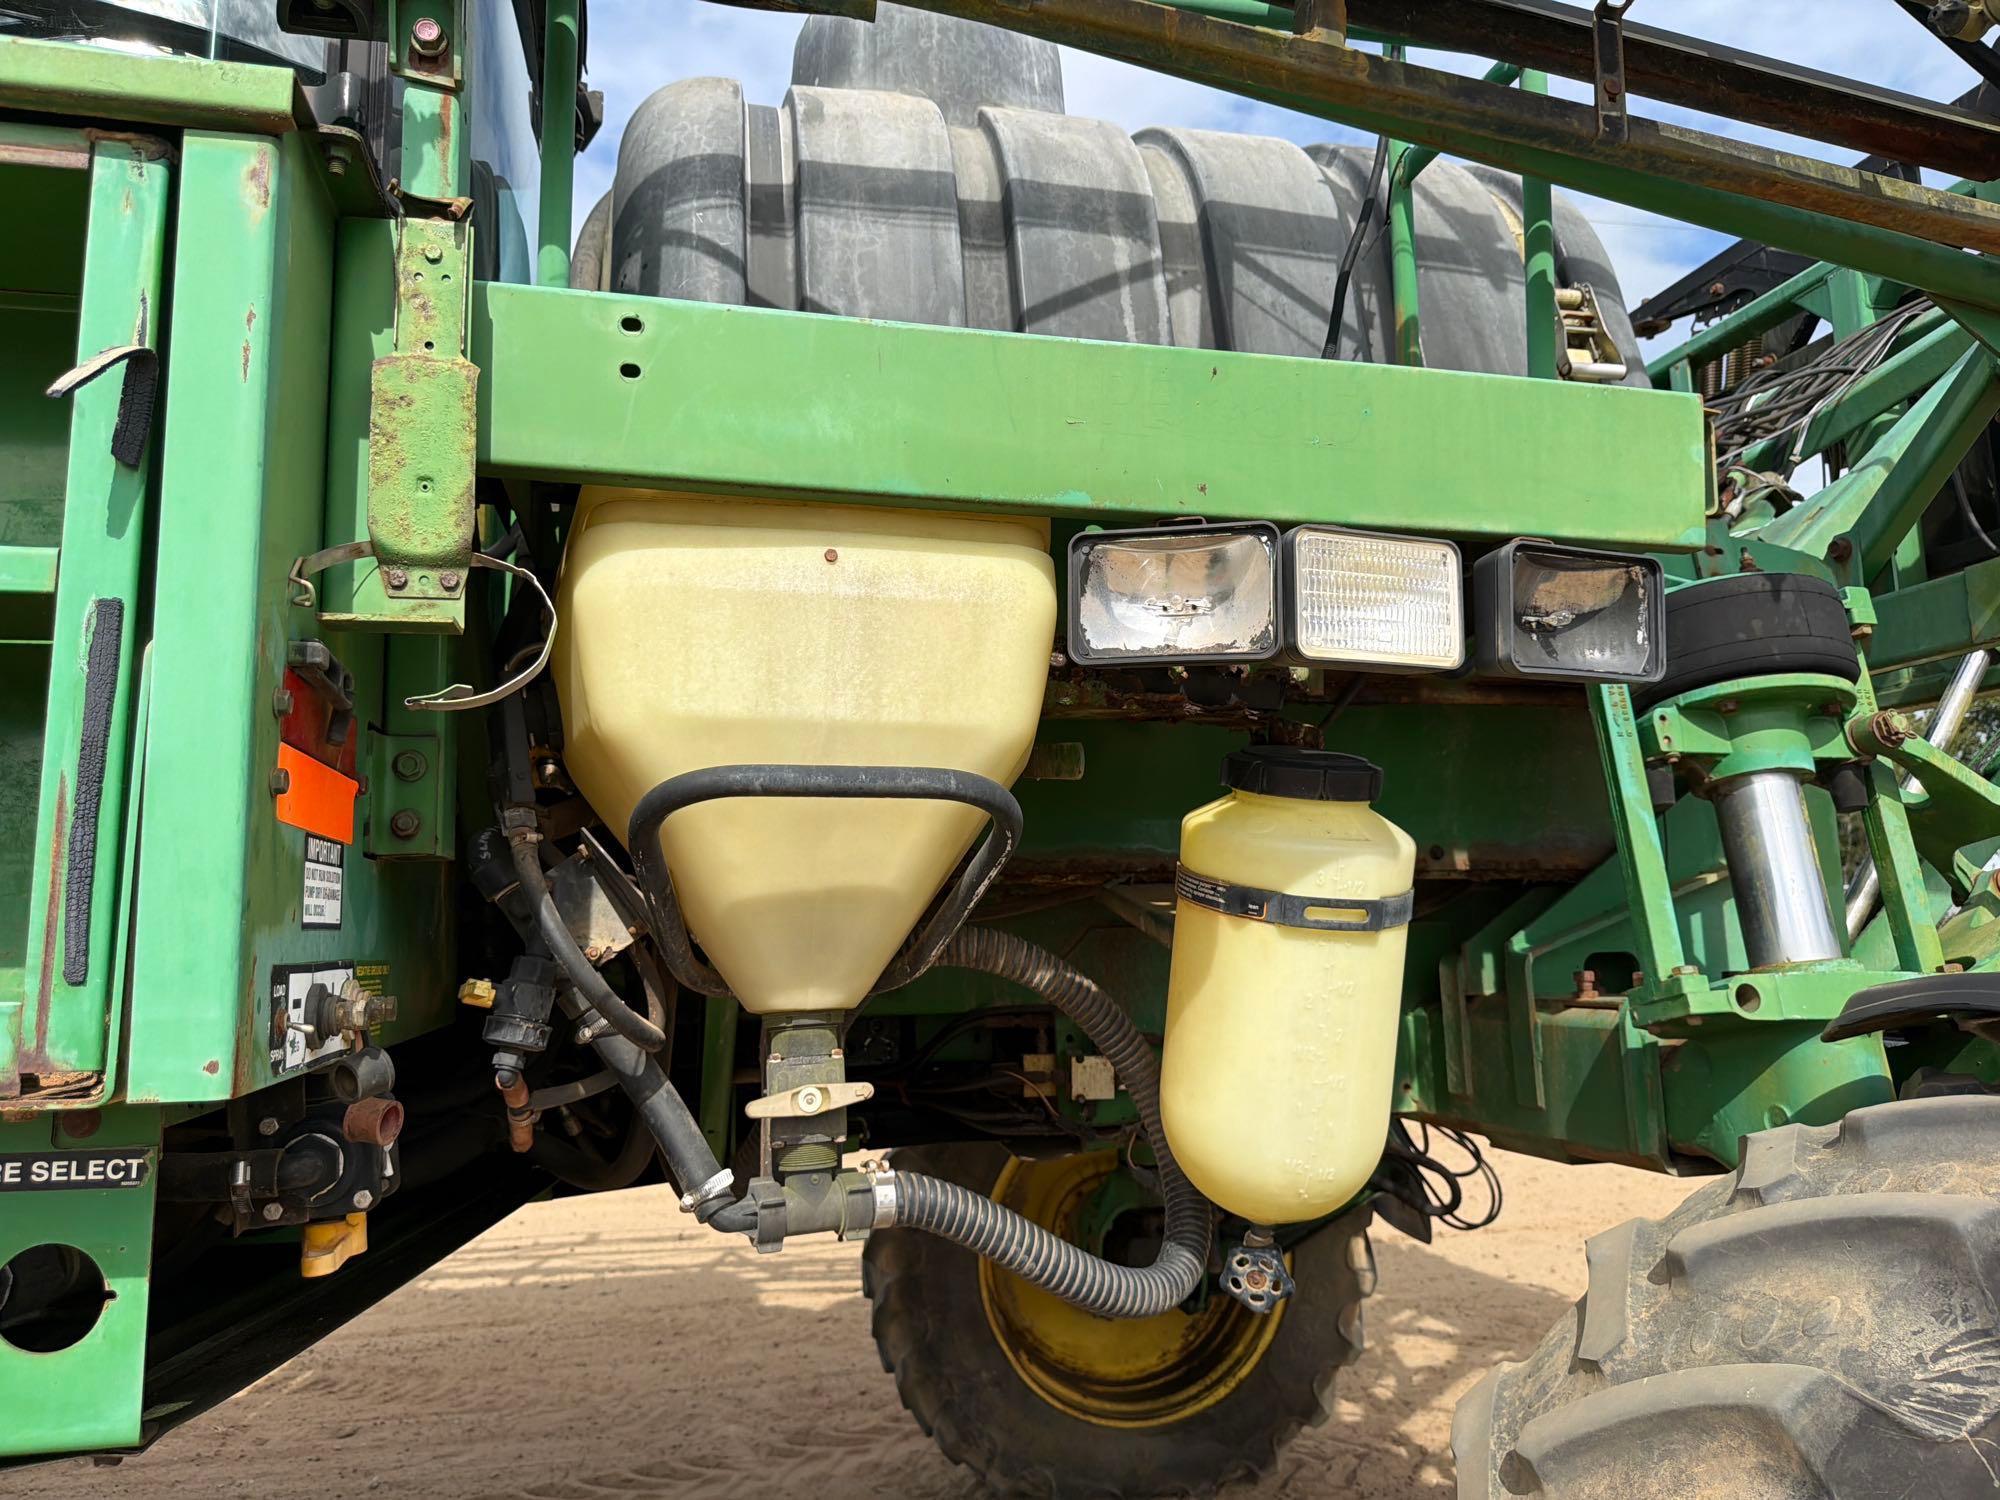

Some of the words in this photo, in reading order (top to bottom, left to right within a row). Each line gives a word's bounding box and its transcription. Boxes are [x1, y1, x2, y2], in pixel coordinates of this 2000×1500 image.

[307, 837, 341, 866] IMPORTANT
[273, 984, 287, 998] LOAD
[0, 1161, 22, 1183] E
[31, 1158, 144, 1182] SELECT
